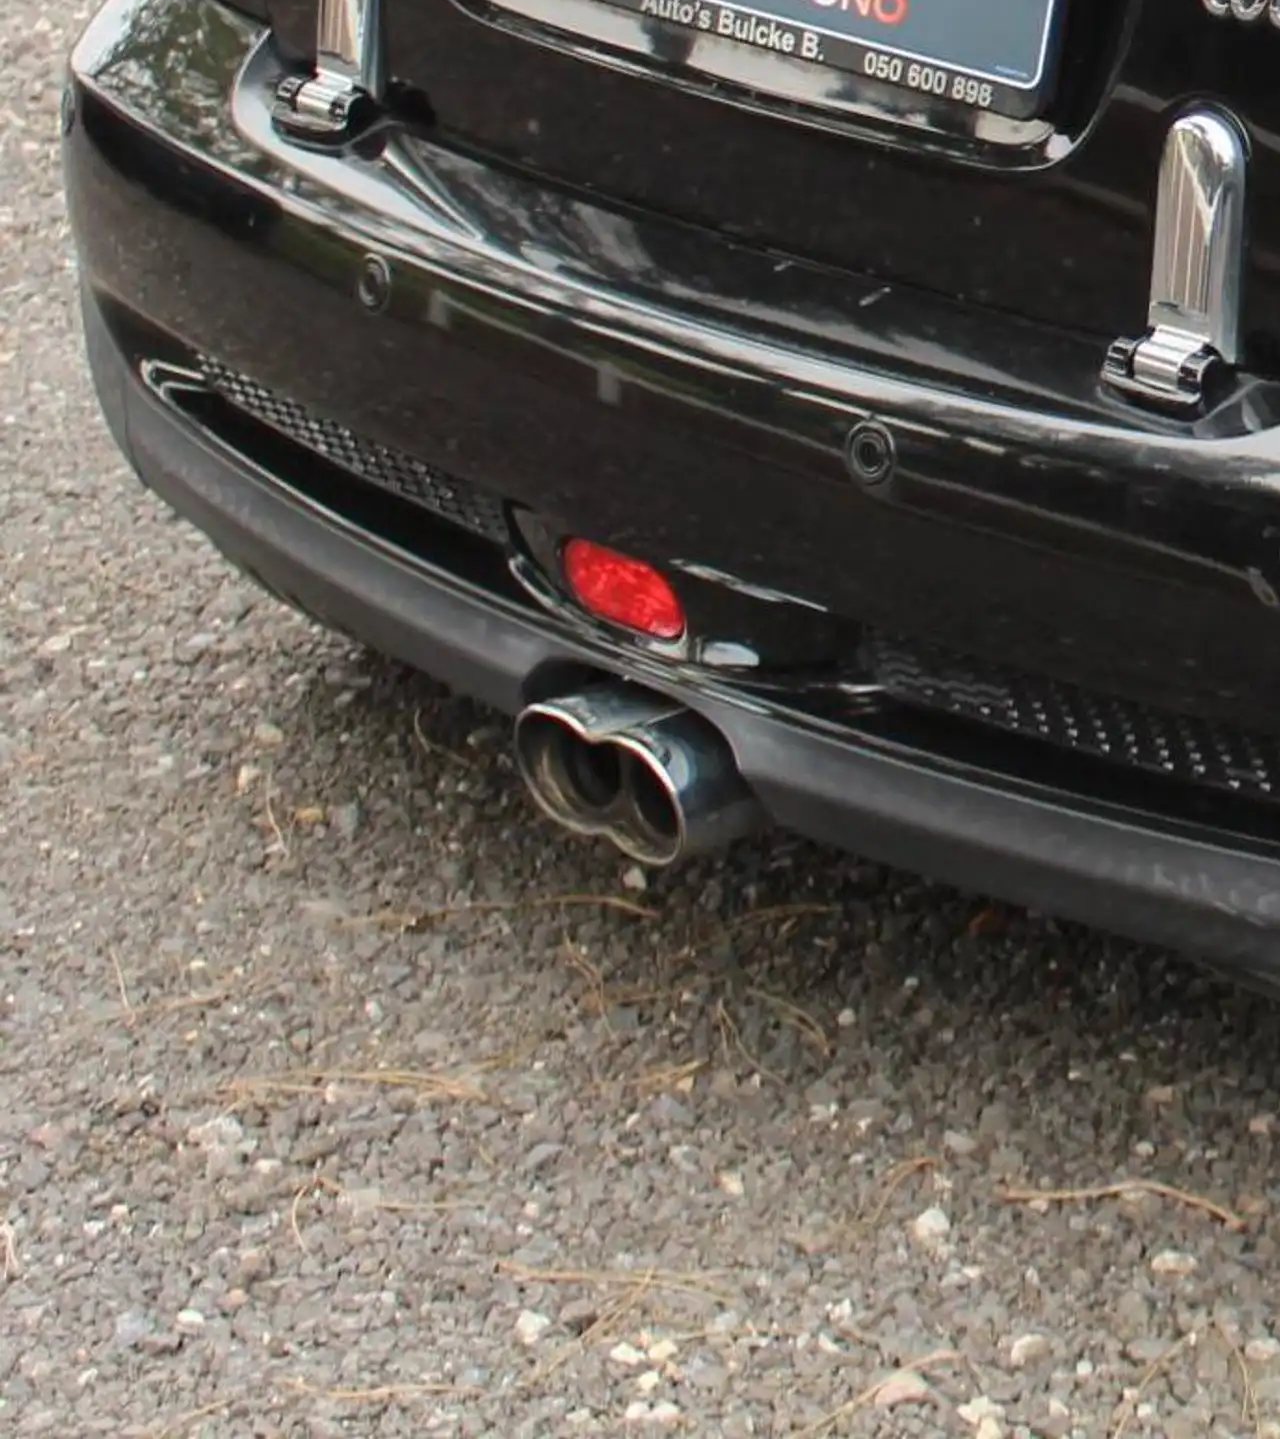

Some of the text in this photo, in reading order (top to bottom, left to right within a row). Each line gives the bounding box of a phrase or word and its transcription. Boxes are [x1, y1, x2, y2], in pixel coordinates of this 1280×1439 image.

[717, 9, 796, 54] Bulcke
[802, 32, 825, 62] B.
[864, 50, 994, 108] 050 600 898
